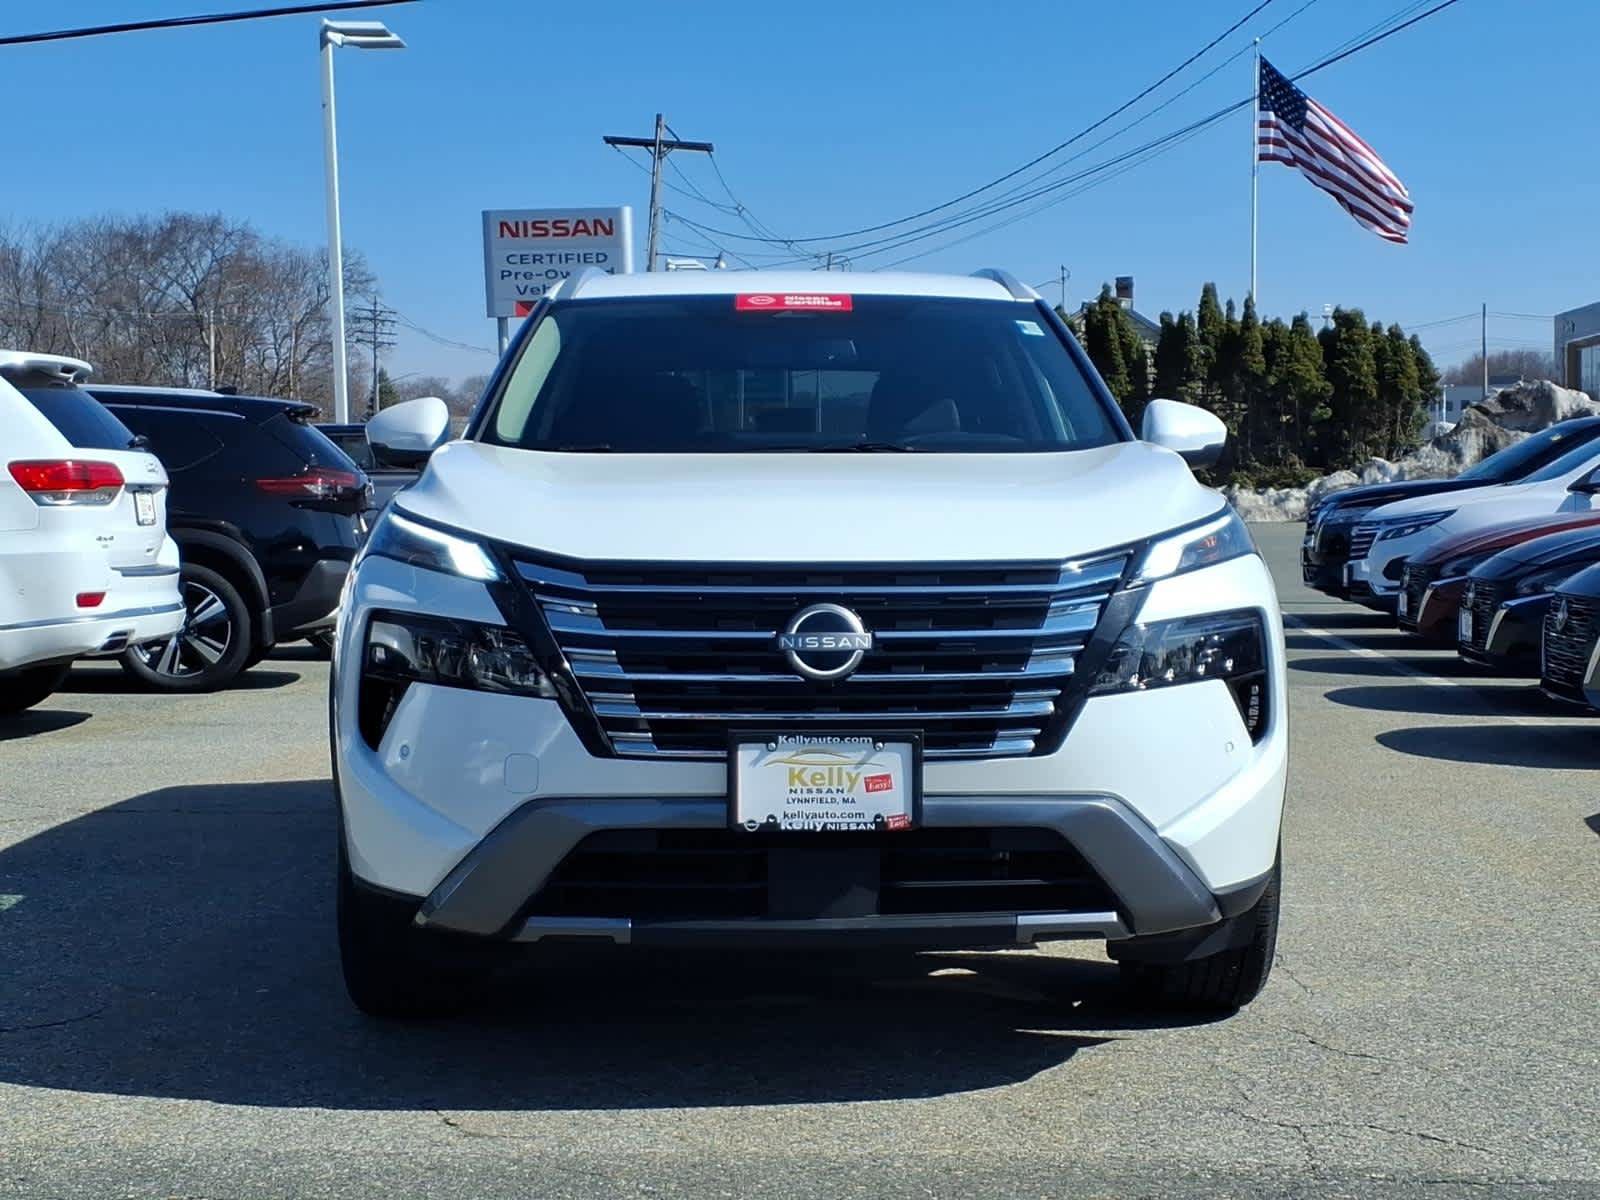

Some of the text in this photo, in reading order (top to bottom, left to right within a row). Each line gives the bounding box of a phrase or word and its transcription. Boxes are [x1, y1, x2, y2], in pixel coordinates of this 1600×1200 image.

[499, 218, 614, 238] NISSAN
[506, 252, 608, 265] CERTIFIED
[781, 636, 869, 649] NISSAN
[778, 735, 873, 745] Kellyauto.com
[788, 767, 861, 793] Kelly
[789, 787, 845, 795] NISSAN
[786, 797, 856, 806] LYNNFIELD, MA
[783, 811, 865, 821] kellyauto.com
[781, 820, 876, 832] Kelly NISSAN
